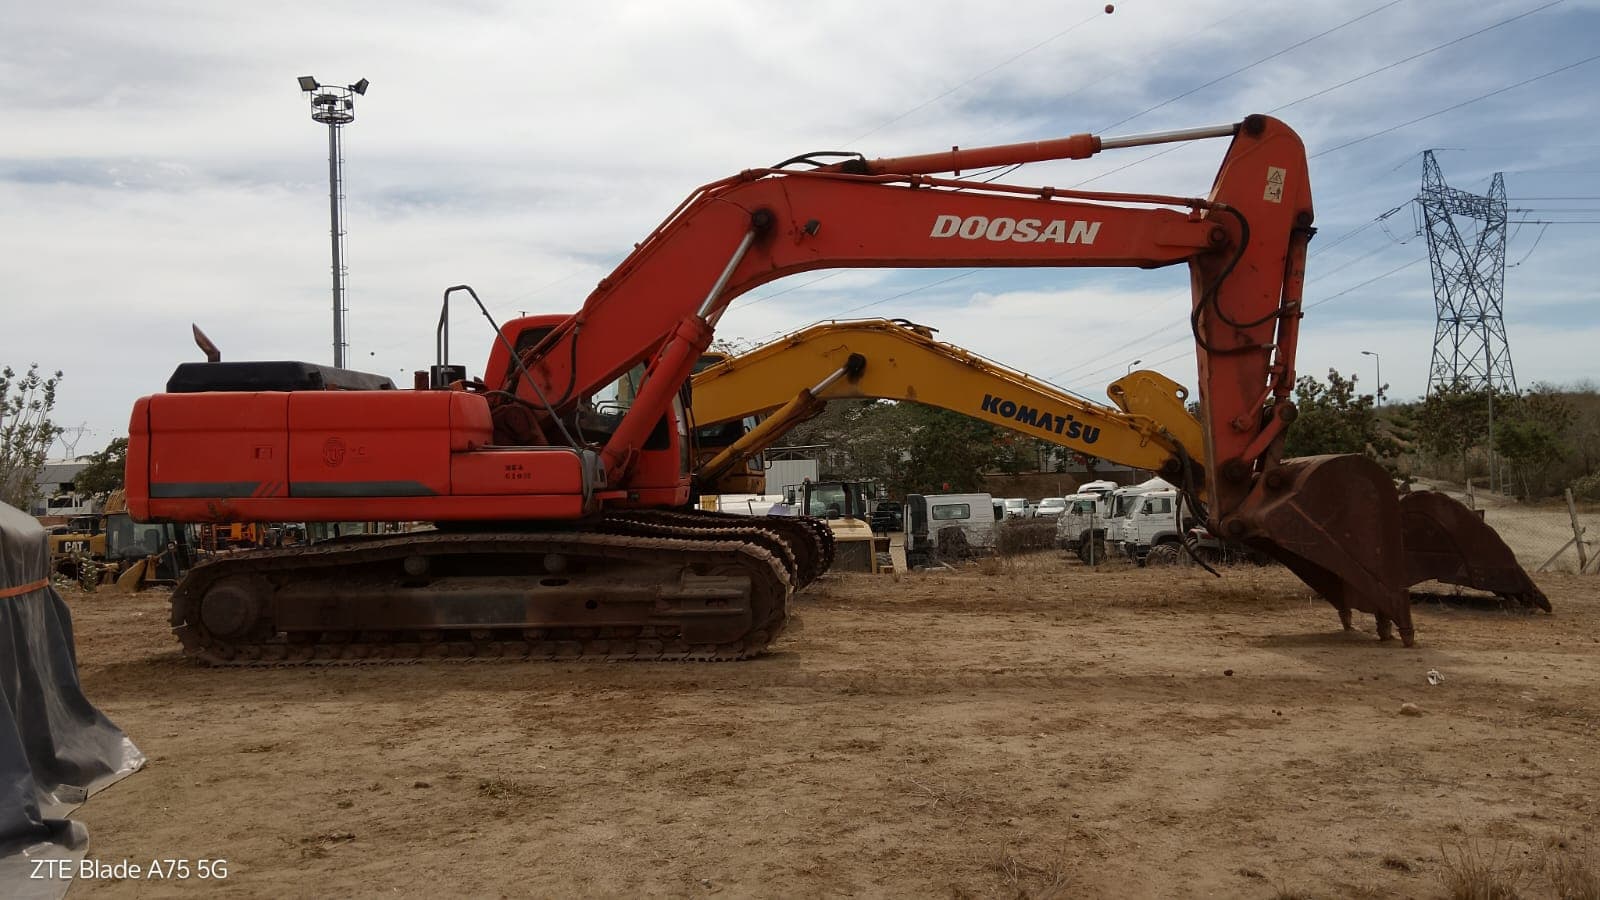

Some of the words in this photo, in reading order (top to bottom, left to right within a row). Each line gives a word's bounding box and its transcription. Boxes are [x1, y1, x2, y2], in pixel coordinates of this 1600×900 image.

[929, 214, 1103, 245] DOOSAN
[981, 393, 1101, 444] KOMATSU
[64, 541, 84, 553] CAT
